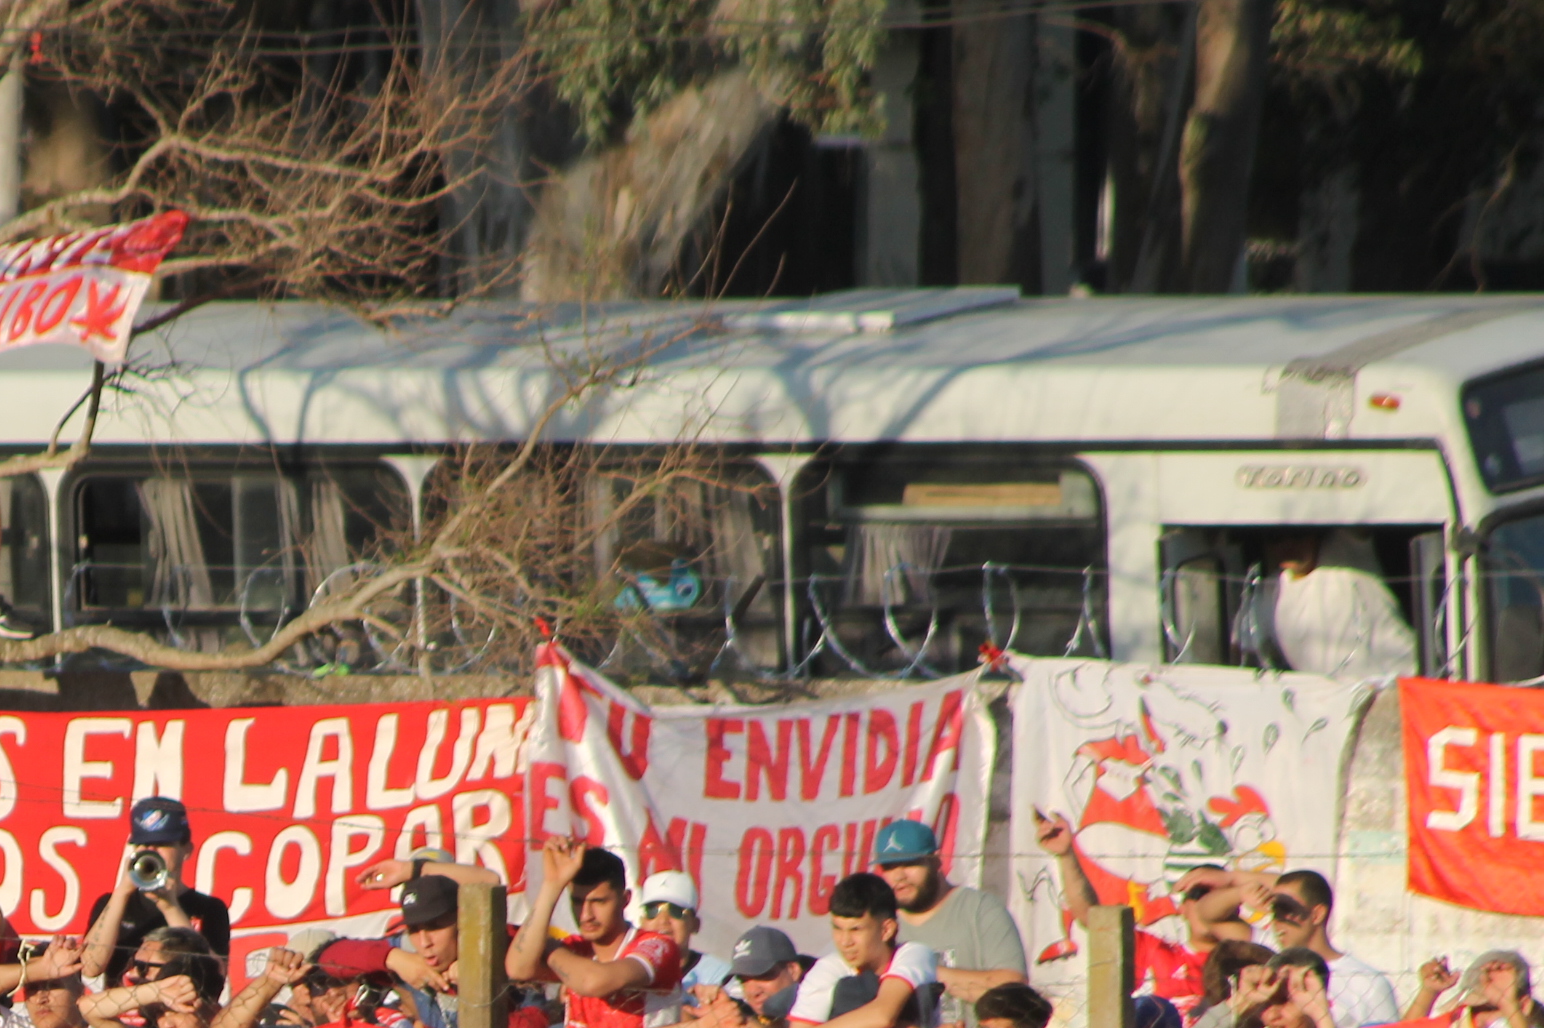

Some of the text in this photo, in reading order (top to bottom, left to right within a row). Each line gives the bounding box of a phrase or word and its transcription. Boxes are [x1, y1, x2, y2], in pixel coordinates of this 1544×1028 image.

[62, 716, 185, 819] EN
[365, 702, 542, 811] LUN
[702, 690, 963, 801] ENVIDIA
[194, 788, 511, 924] COPAR
[734, 792, 962, 919] ORGUO
